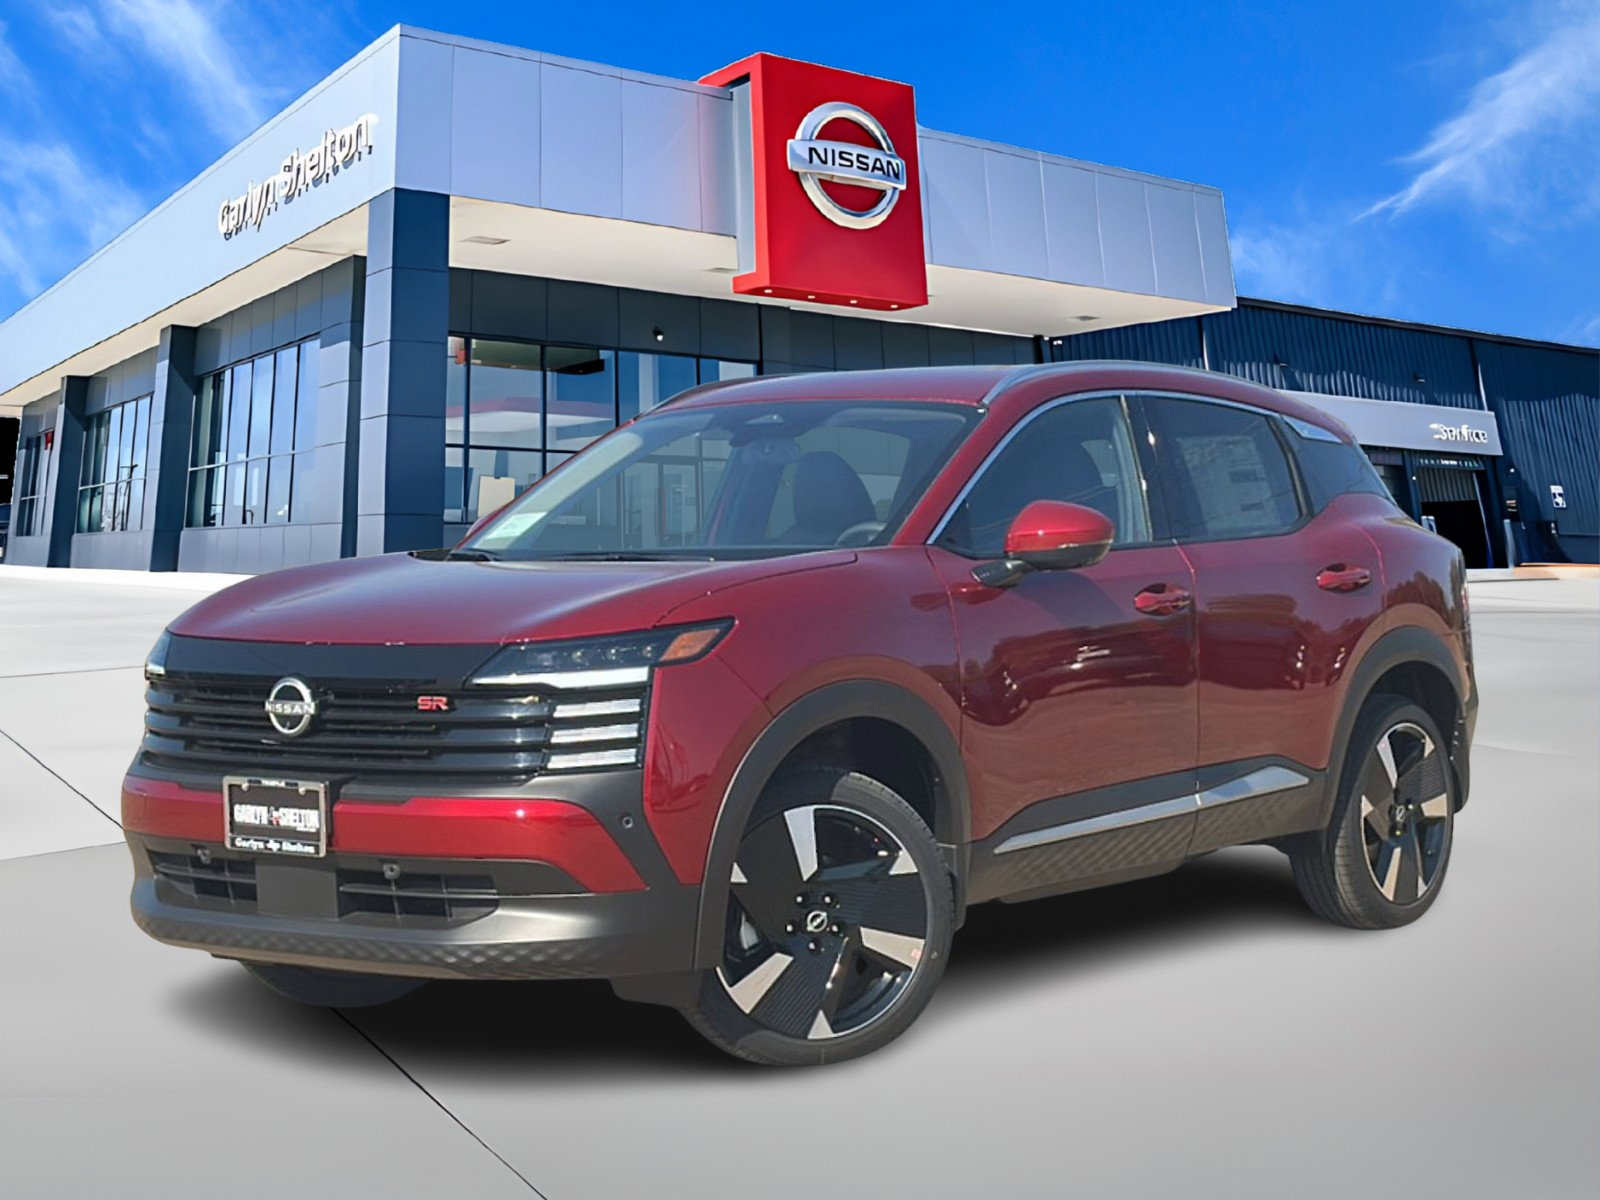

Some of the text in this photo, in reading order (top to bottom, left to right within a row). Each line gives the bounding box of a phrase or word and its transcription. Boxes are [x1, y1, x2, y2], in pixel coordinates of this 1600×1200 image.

[808, 146, 900, 180] NISSAN
[264, 700, 316, 715] NISSAN
[417, 696, 450, 711] SR
